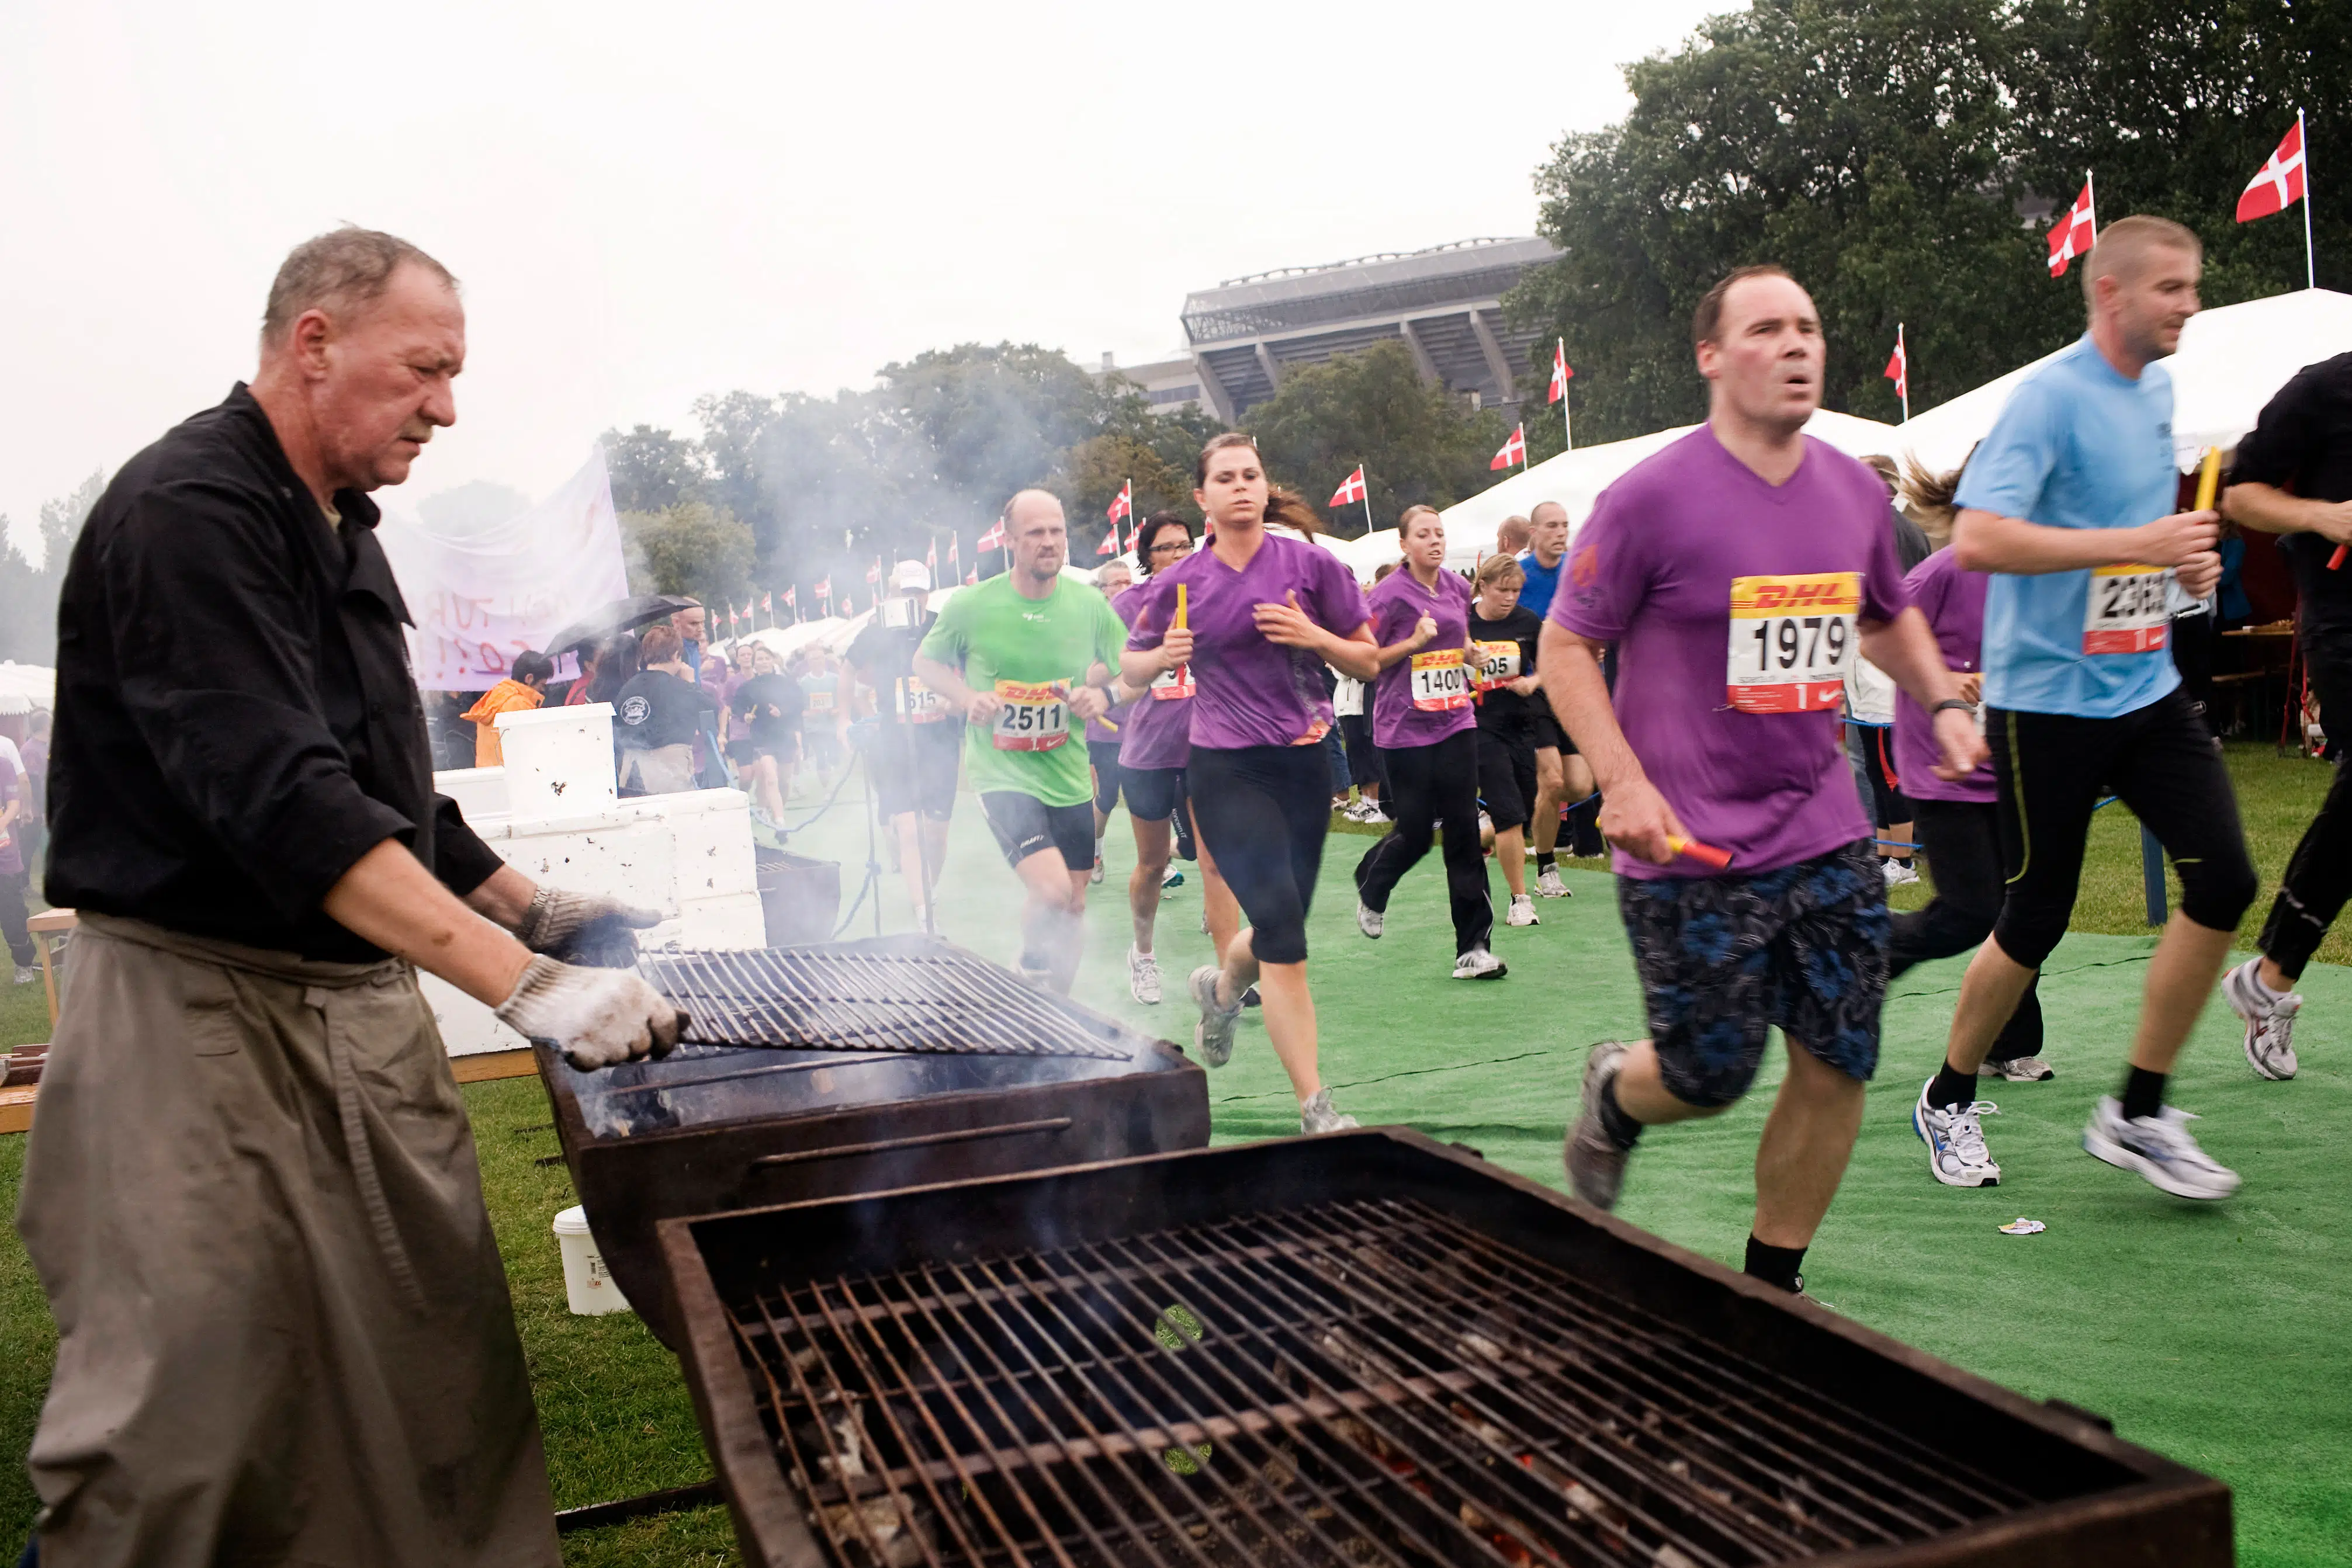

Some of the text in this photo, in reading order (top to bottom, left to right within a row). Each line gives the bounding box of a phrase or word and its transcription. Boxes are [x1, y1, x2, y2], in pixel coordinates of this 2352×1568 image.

[1754, 583, 1842, 608] DHL
[1752, 616, 1845, 671] 1979
[1422, 654, 1457, 667] DHL
[1481, 657, 1508, 677] 05
[1421, 669, 1460, 693] 1400
[1795, 684, 1807, 709] 1
[1002, 703, 1061, 731] 2511
